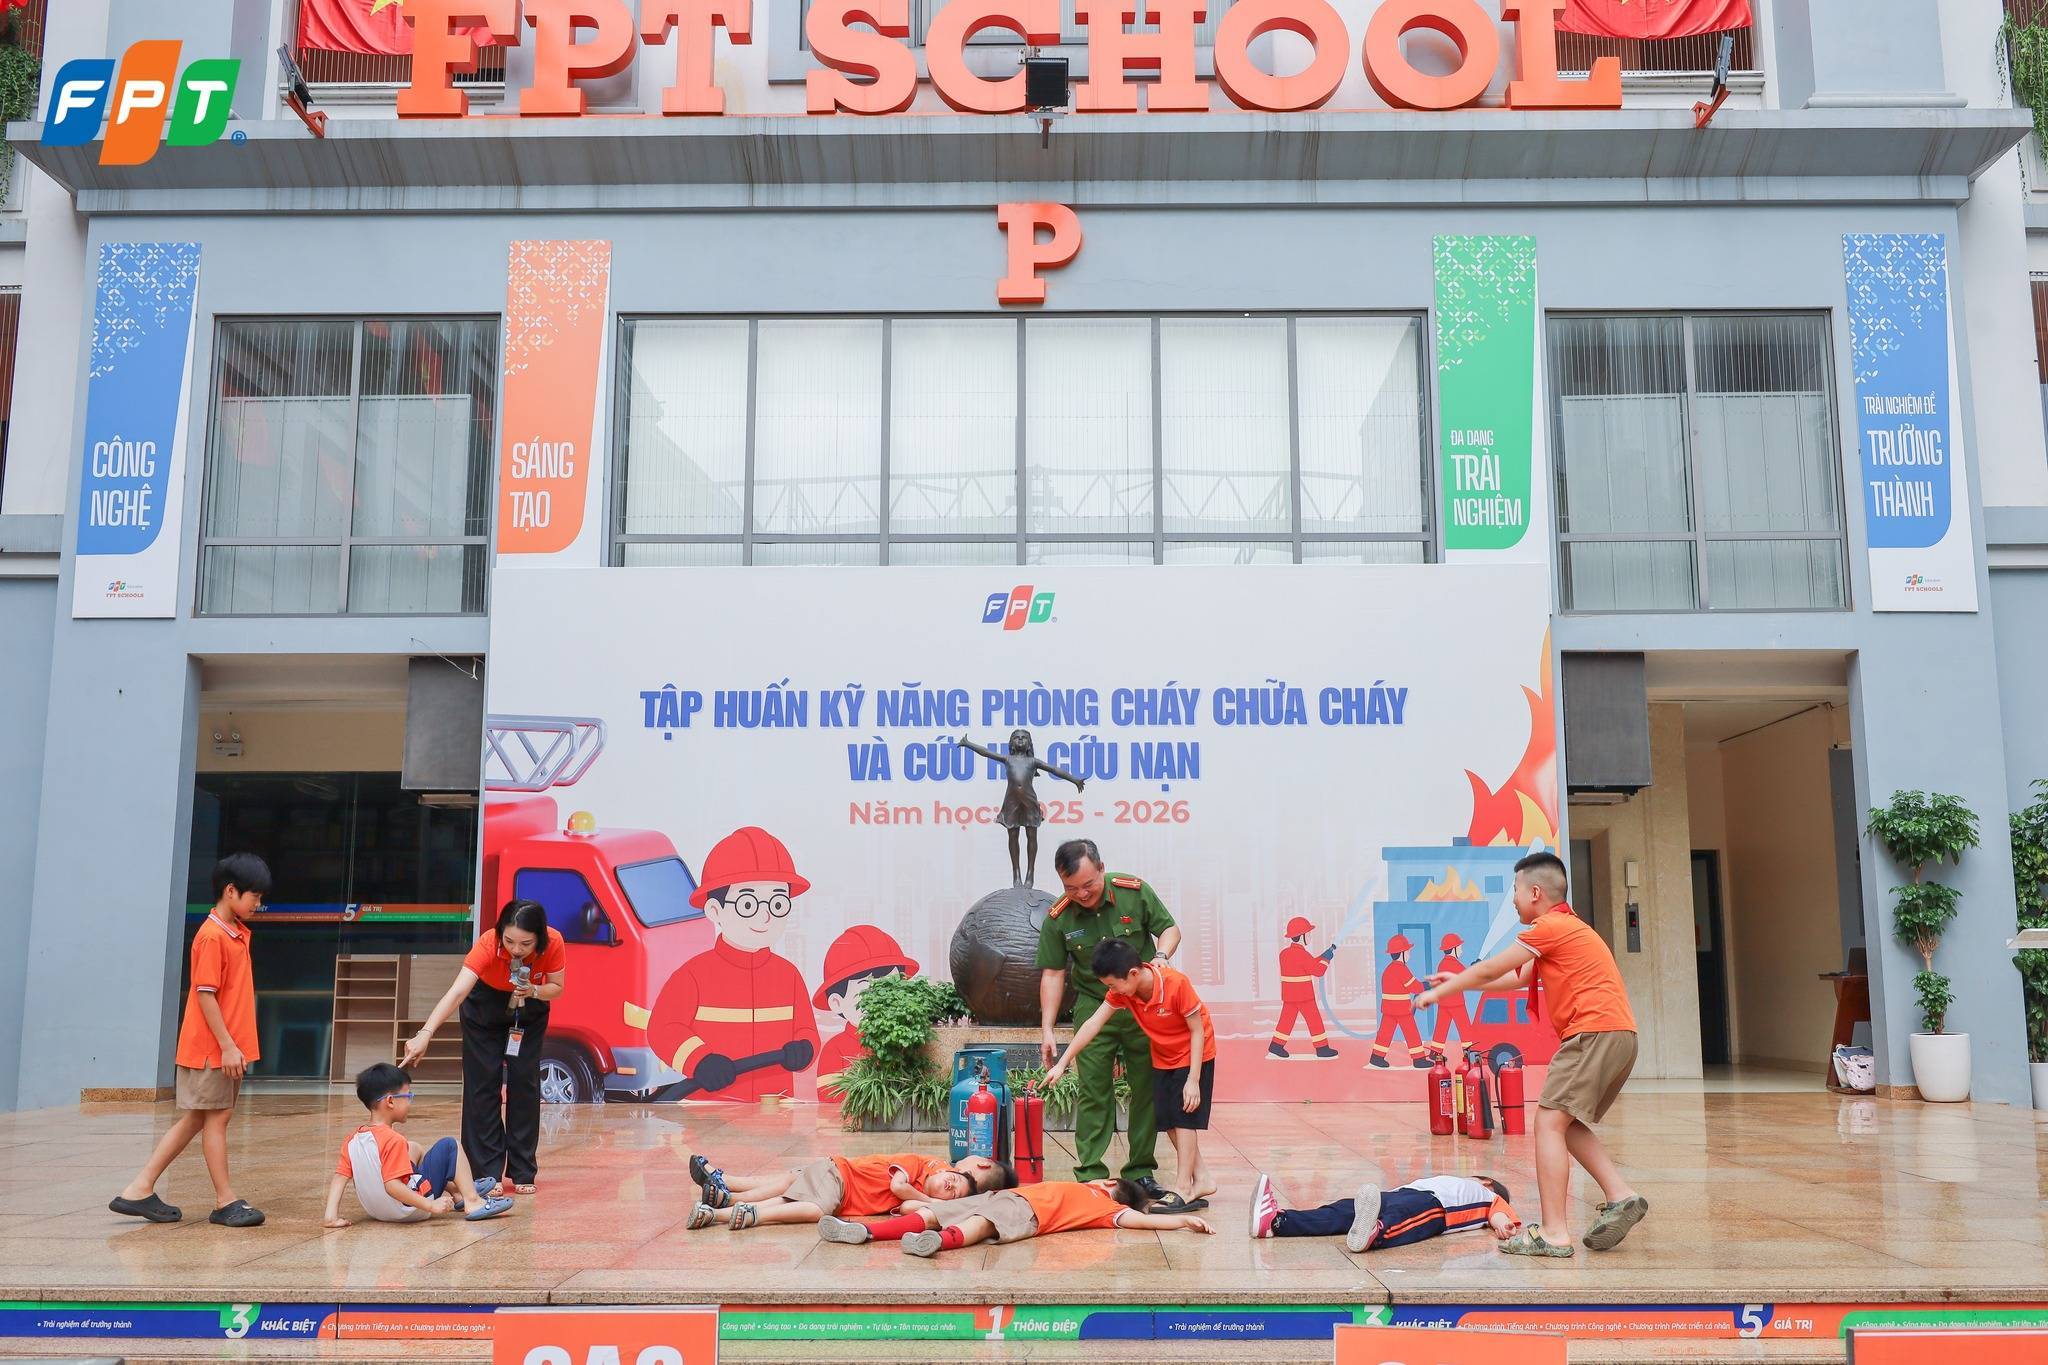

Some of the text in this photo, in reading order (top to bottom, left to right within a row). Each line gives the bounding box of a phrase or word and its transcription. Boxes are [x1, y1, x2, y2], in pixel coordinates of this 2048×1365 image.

[398, 0, 1622, 116] FPT SCHOOL
[998, 203, 1083, 304] P
[1863, 390, 1937, 417] TRẢI NGHIỆM ĐỂ
[92, 434, 156, 478] CÔNG
[511, 435, 575, 479] SÁNG
[1450, 429, 1494, 448] ĐA DẠNG
[1866, 423, 1943, 466] TRƯỞNG
[1450, 447, 1501, 491] TRẢI
[90, 482, 153, 531] NGHỆ
[509, 490, 552, 533] TẠO
[1453, 493, 1523, 530] NGHIỆM
[1869, 474, 1935, 517] THÀNH
[639, 677, 1409, 741] TẬP HUẤN KỸ NĂNG PHÒNG CHÁY CHỮA CHÁY
[848, 735, 891, 781] VÀ
[904, 735, 975, 781] CỨU
[1047, 735, 1119, 781] CỨU
[1130, 741, 1200, 792] NẠN
[849, 801, 923, 825] Năm
[1114, 800, 1190, 824] 2026
[342, 904, 356, 921] 5
[56, 1320, 79, 1329] nghiệm
[113, 1320, 132, 1328] thành
[225, 1304, 316, 1338] 3 KHÁC BIỆT
[452, 1323, 468, 1332] Công
[985, 1305, 1078, 1339] 1 THÔNG ĐIỆP
[1188, 1323, 1211, 1332] nghiệm
[1588, 1322, 1604, 1331] Công
[1739, 1304, 1813, 1338] 5 GIÁ TRỊ
